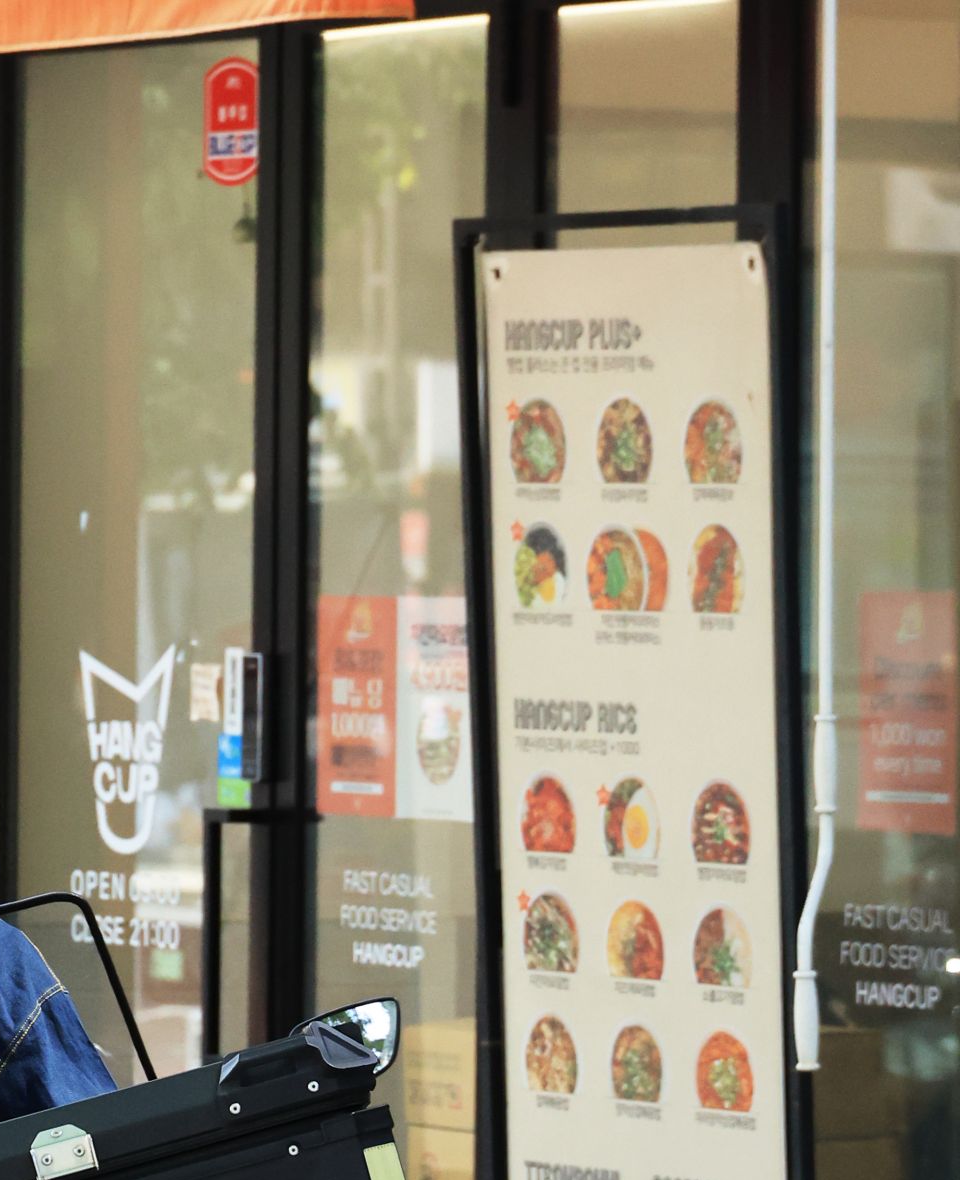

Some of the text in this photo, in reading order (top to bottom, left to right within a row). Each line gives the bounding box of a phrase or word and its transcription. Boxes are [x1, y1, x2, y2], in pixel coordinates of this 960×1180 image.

[87, 719, 163, 763] HANG
[93, 760, 159, 803] CUP
[70, 869, 125, 900] OPEN
[344, 870, 378, 894] FAST
[129, 918, 180, 949] 21:00
[341, 904, 437, 934] FOOD SERVICE
[843, 903, 954, 934] FAST CASUAL
[353, 941, 425, 968] HANGCUP
[840, 941, 886, 969] FOOD
[855, 980, 941, 1009] HANGCUP
